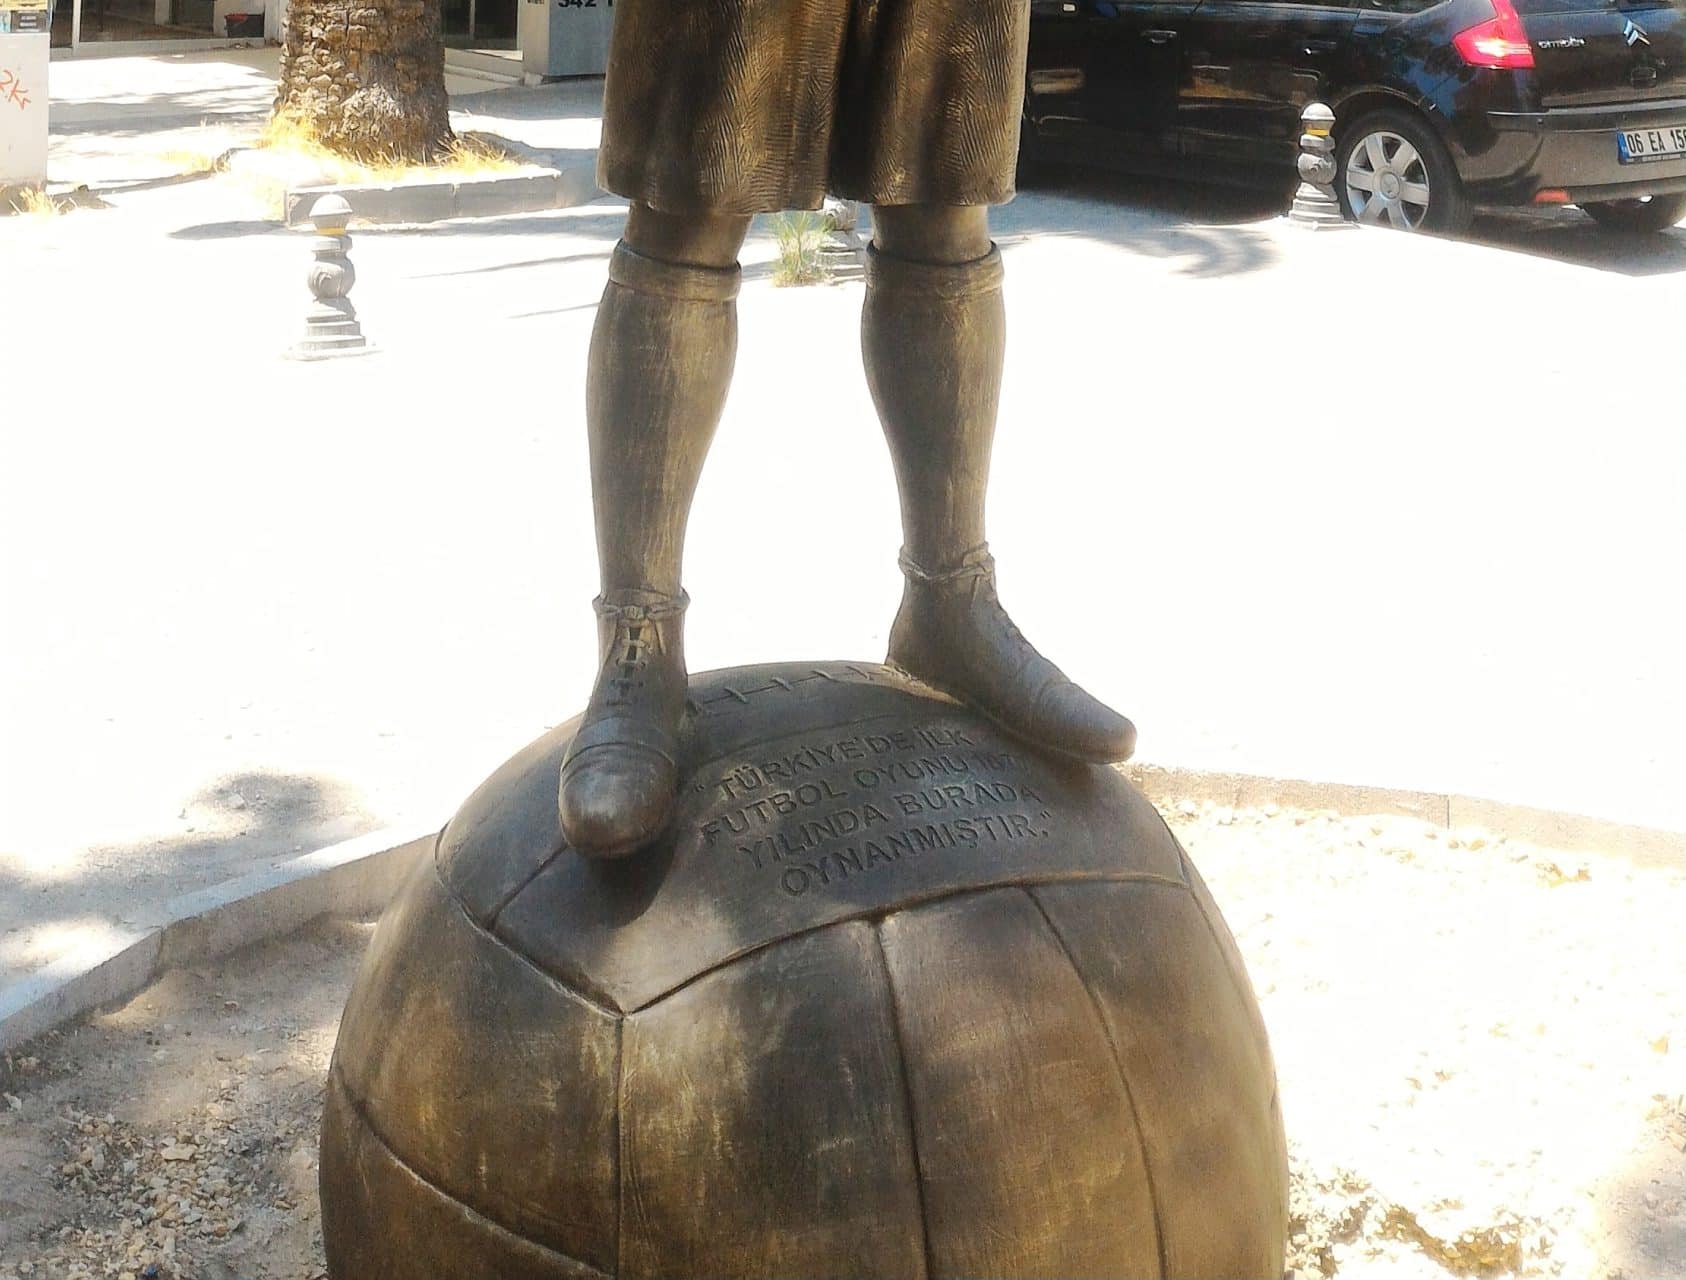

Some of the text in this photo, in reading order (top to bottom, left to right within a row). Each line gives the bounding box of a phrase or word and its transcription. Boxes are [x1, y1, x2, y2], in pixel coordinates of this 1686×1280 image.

[1626, 132, 1645, 154] 06
[1647, 130, 1666, 152] EA
[912, 725, 976, 751] İLK
[700, 780, 848, 848] FUTBOL
[853, 753, 969, 789] OYUNU
[738, 780, 1043, 869] YILINDA BURADA
